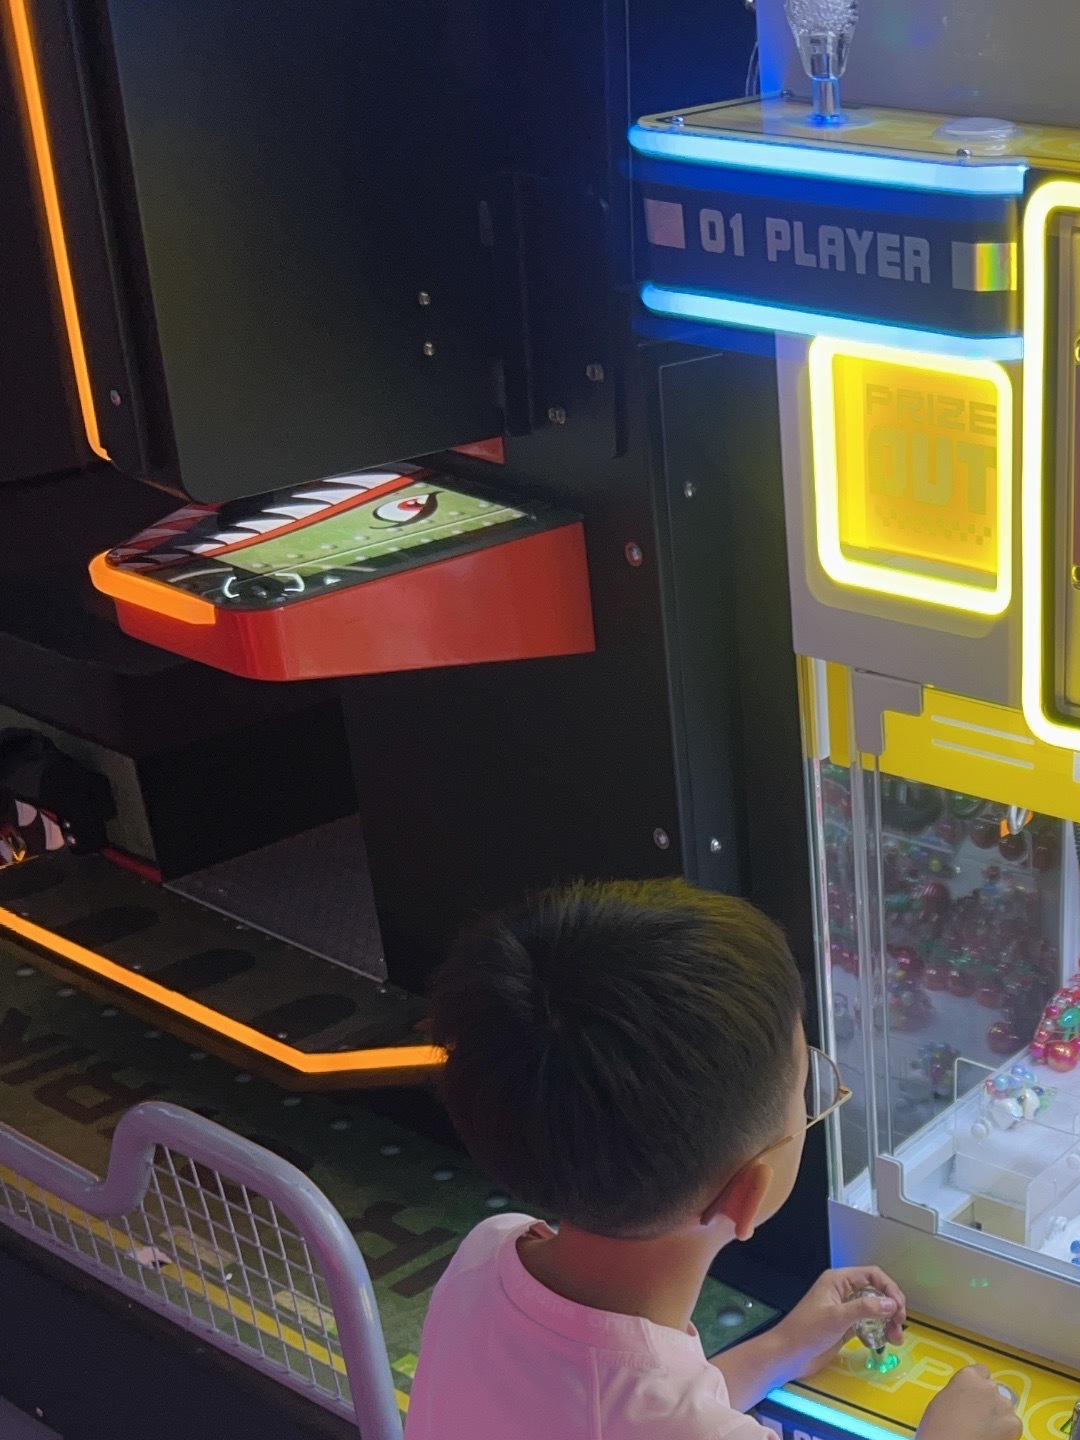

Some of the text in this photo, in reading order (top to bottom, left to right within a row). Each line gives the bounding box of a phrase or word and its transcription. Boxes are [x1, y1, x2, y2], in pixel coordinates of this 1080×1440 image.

[700, 208, 931, 284] 01 PLAYER
[866, 382, 997, 437] PRIZE
[868, 428, 997, 516] OUT
